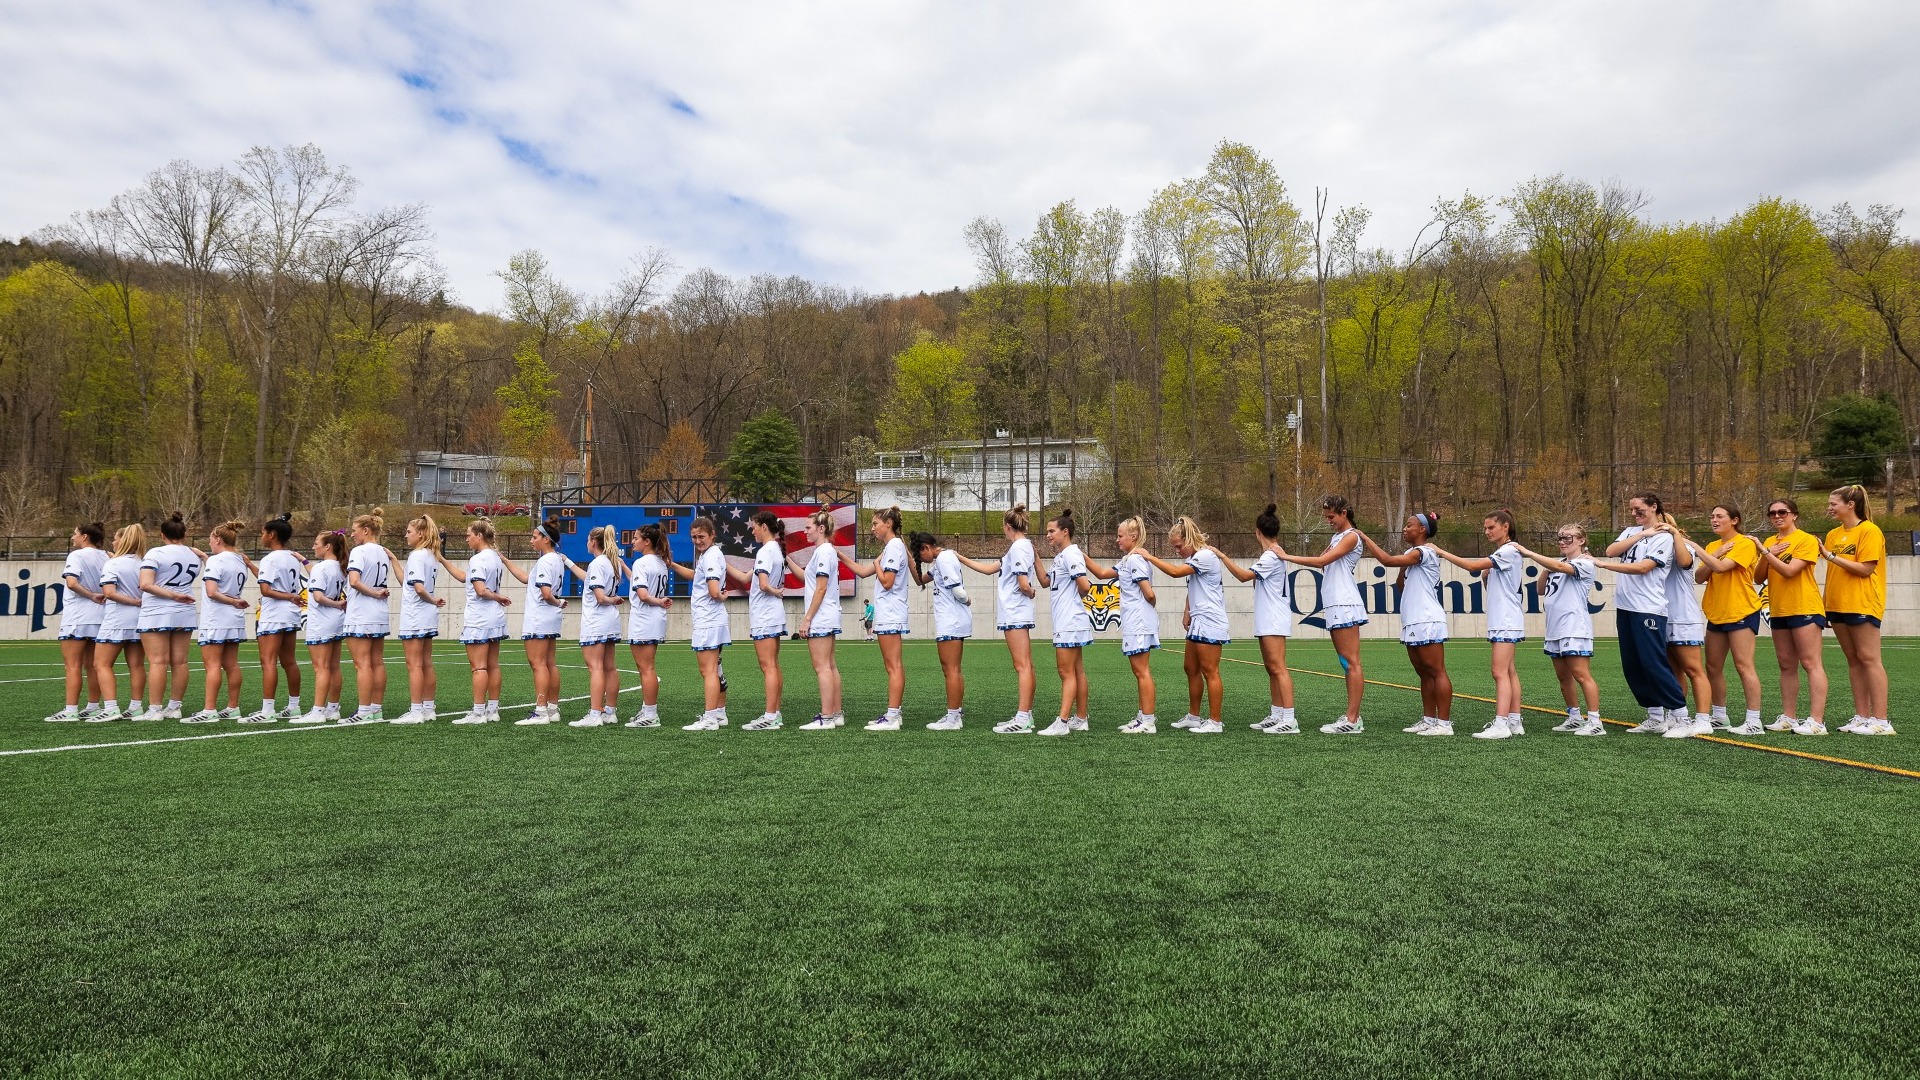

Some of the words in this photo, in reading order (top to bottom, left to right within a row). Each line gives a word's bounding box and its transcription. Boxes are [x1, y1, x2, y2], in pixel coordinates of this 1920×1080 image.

[561, 508, 576, 517] CC
[661, 508, 674, 517] QU
[165, 561, 199, 587] 25
[236, 572, 246, 597] 9
[373, 561, 388, 588] 12
[0, 568, 63, 632] ip
[1643, 618, 1659, 630] Q
